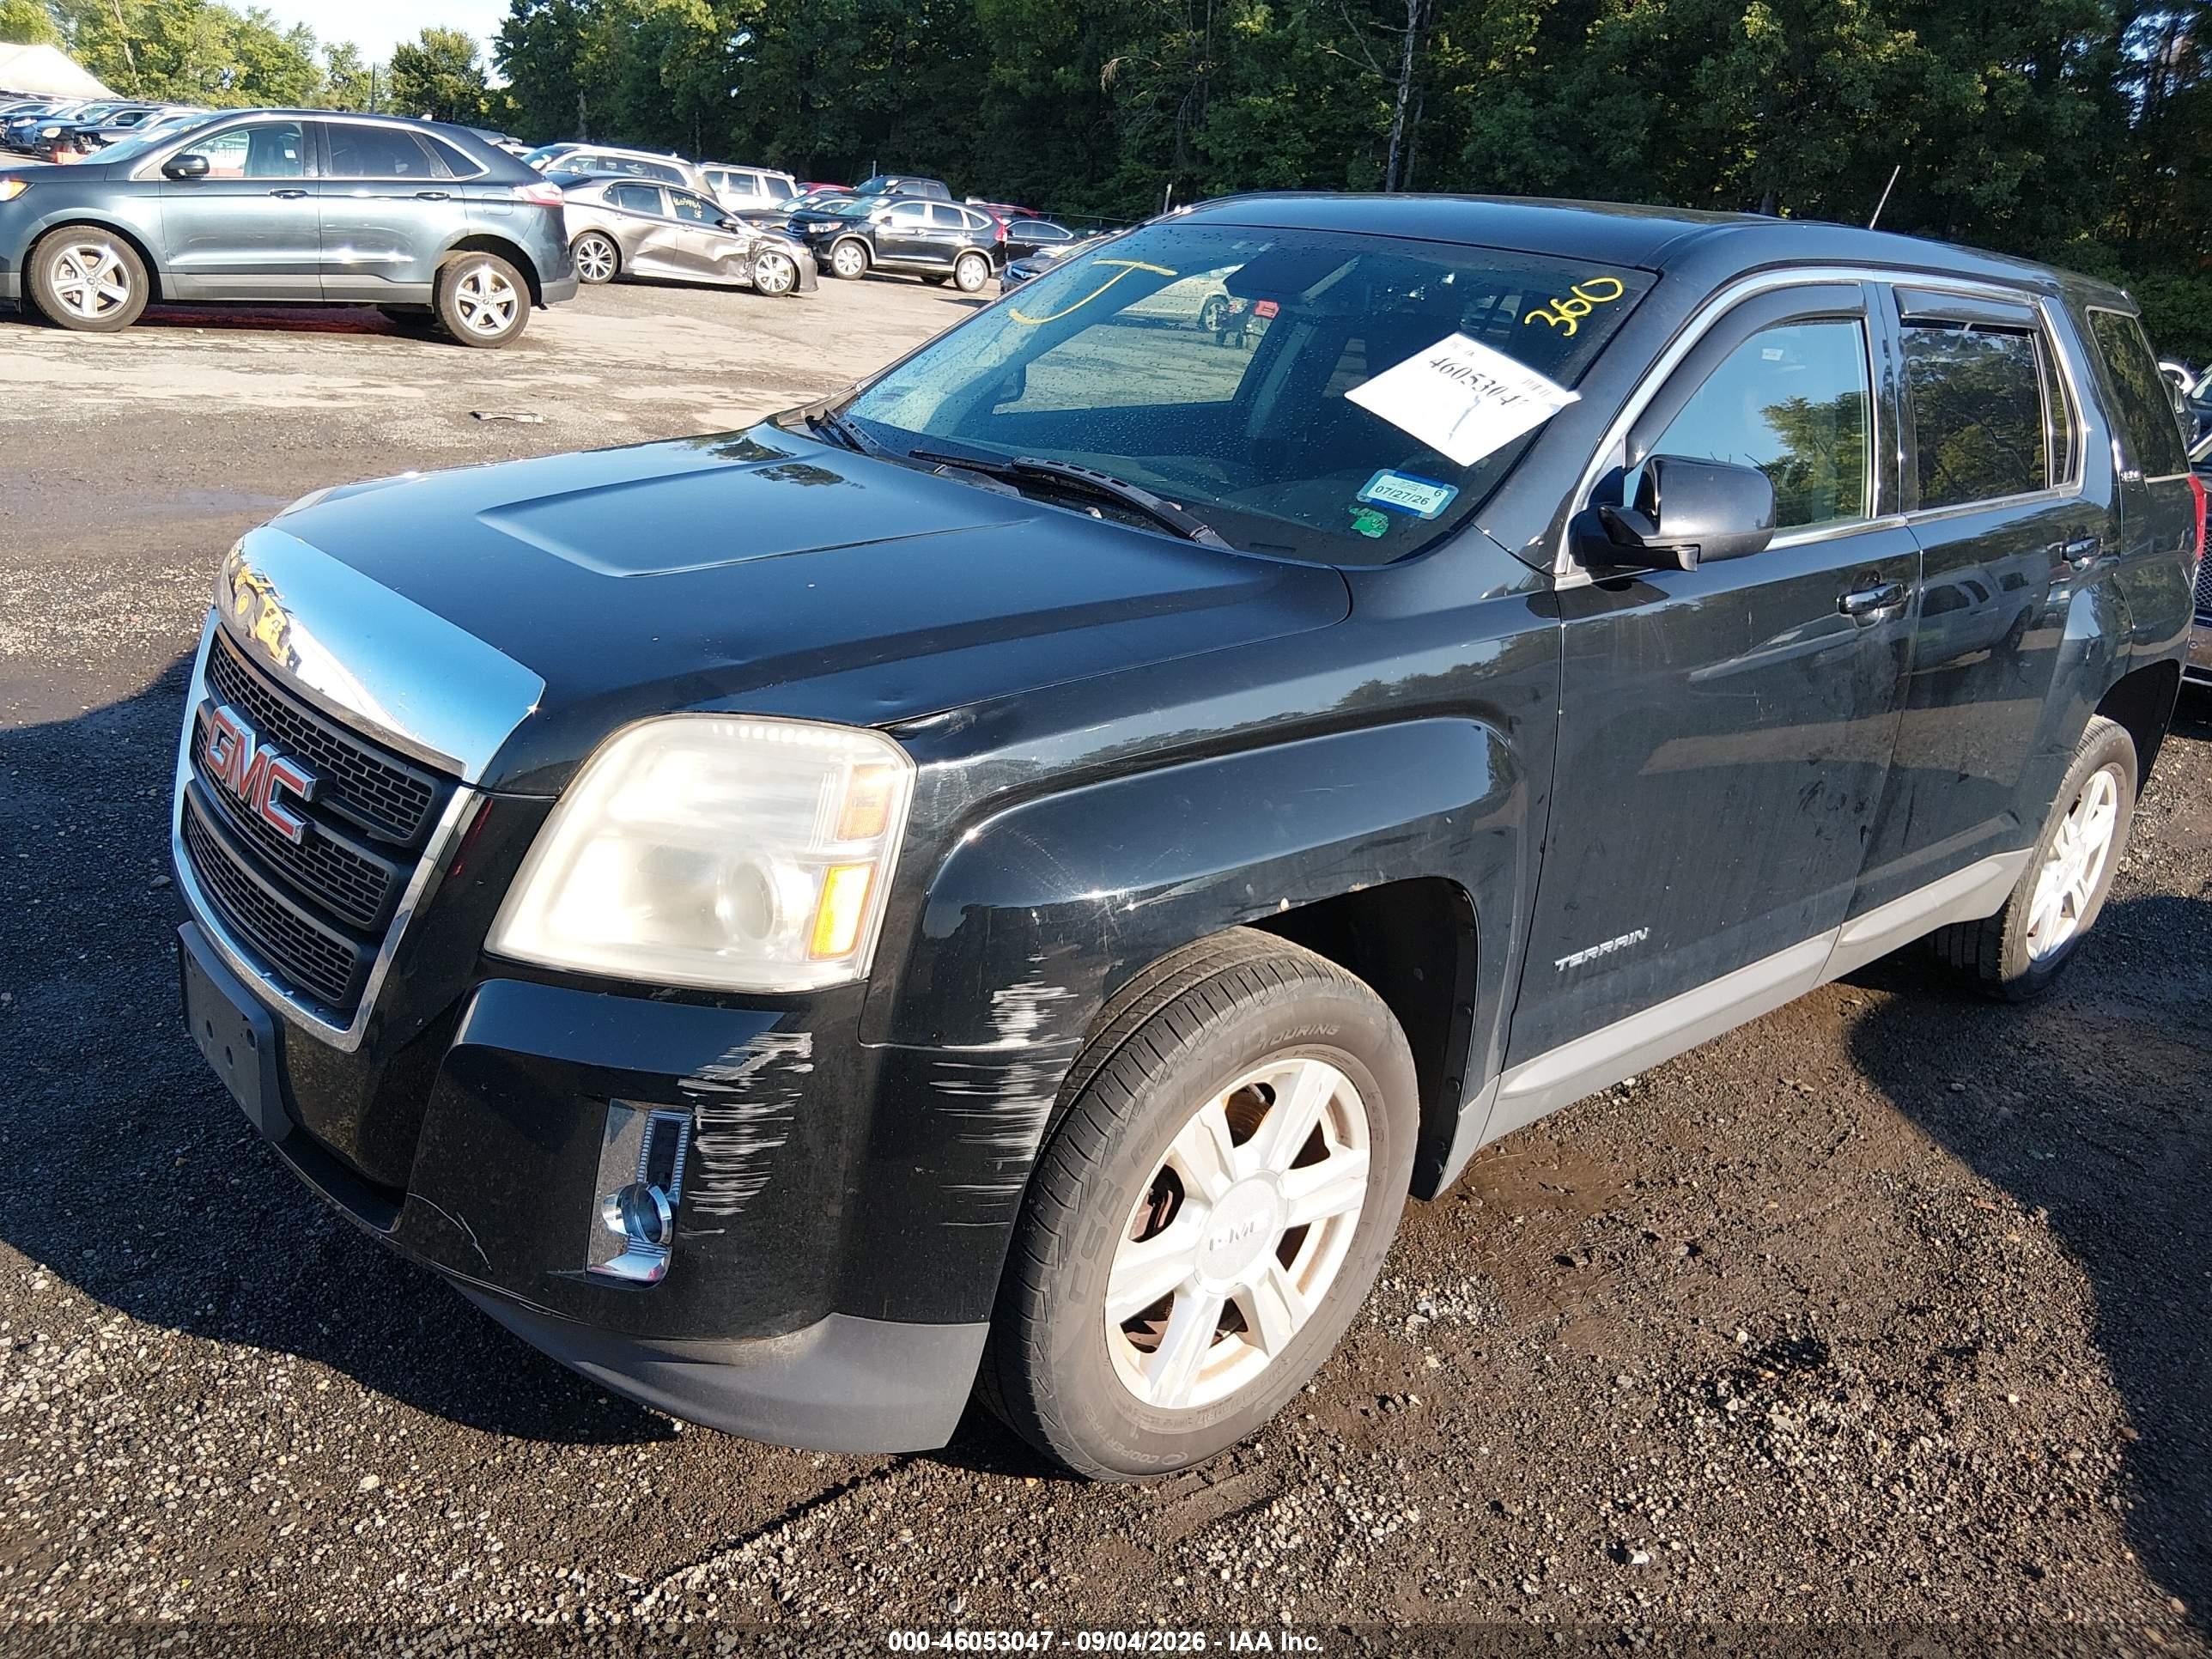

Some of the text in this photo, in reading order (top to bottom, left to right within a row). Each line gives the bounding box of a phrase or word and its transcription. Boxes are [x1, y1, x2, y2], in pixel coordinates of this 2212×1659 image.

[1524, 277, 1625, 336] 360
[1375, 485, 1431, 506] 07/27/26
[206, 705, 317, 845] GMC
[1553, 927, 1650, 972] TERRAIN
[1257, 1023, 1340, 1050] TOURING
